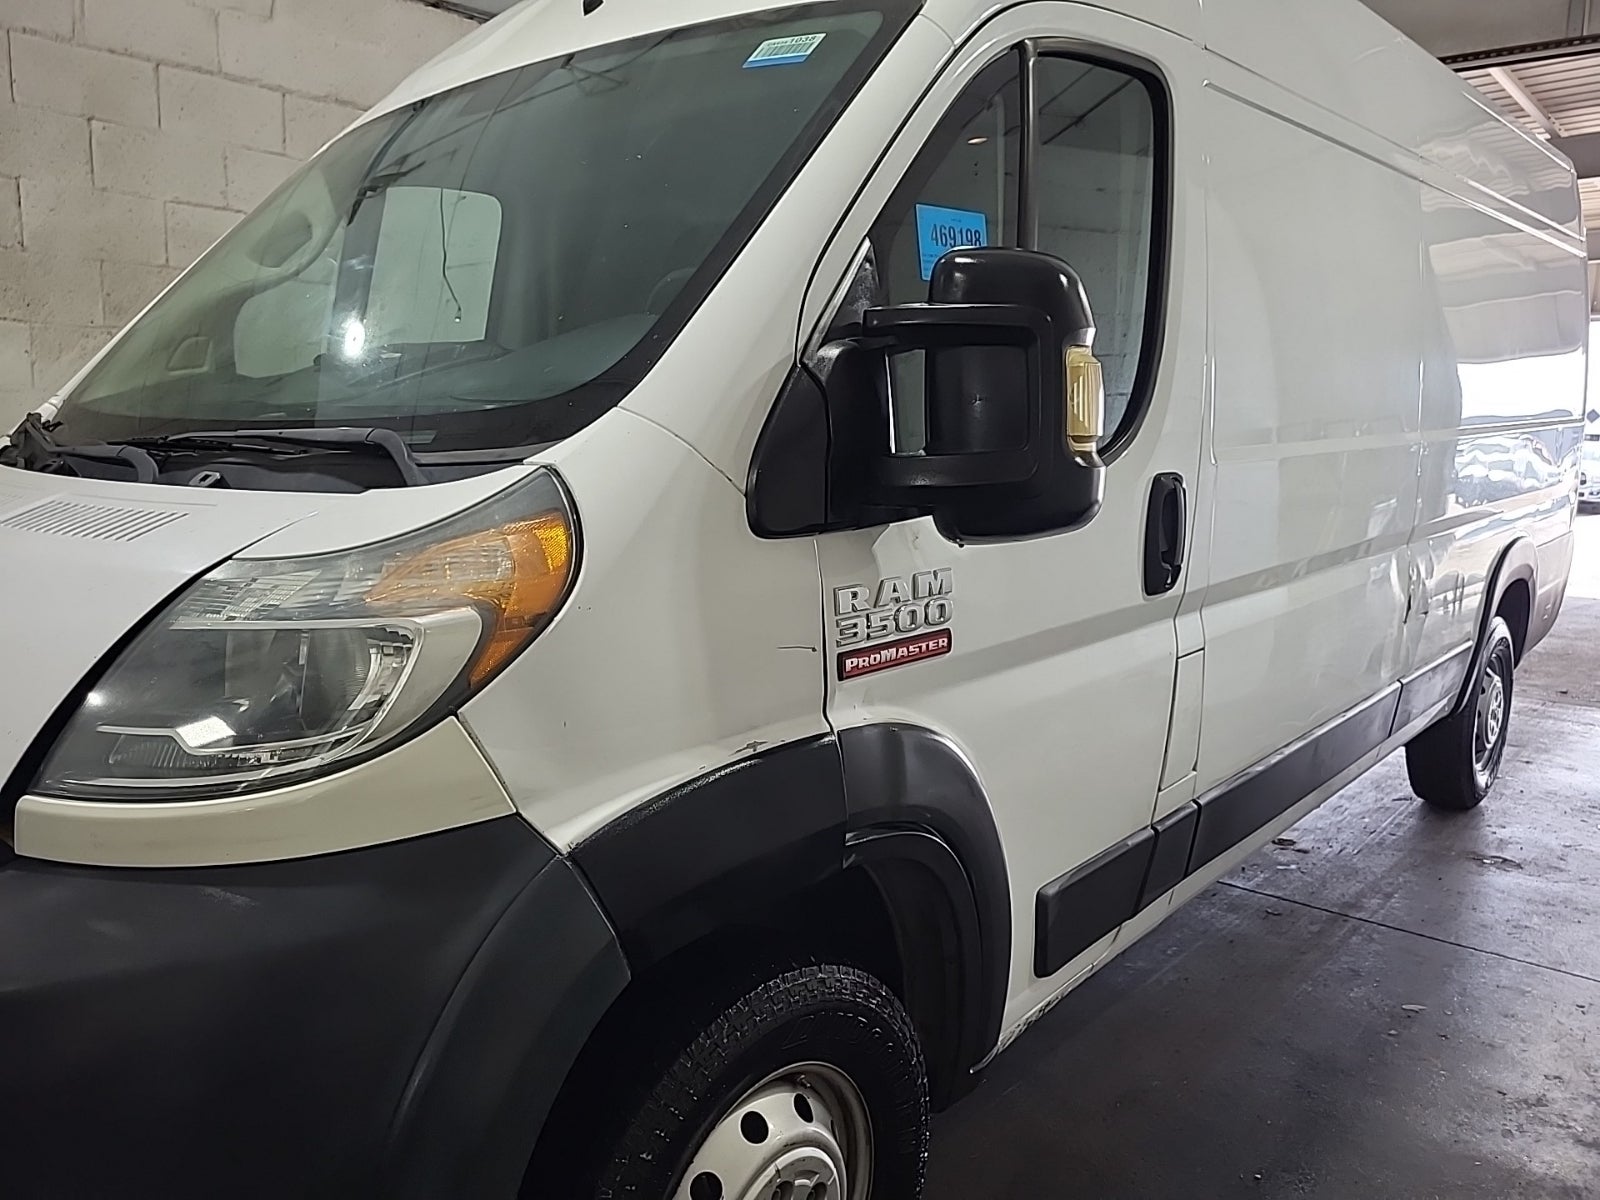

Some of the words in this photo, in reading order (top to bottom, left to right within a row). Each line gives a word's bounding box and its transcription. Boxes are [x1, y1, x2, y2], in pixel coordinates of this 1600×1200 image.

[931, 223, 982, 248] 469198
[833, 567, 952, 616] RAM
[836, 597, 953, 648] 3500
